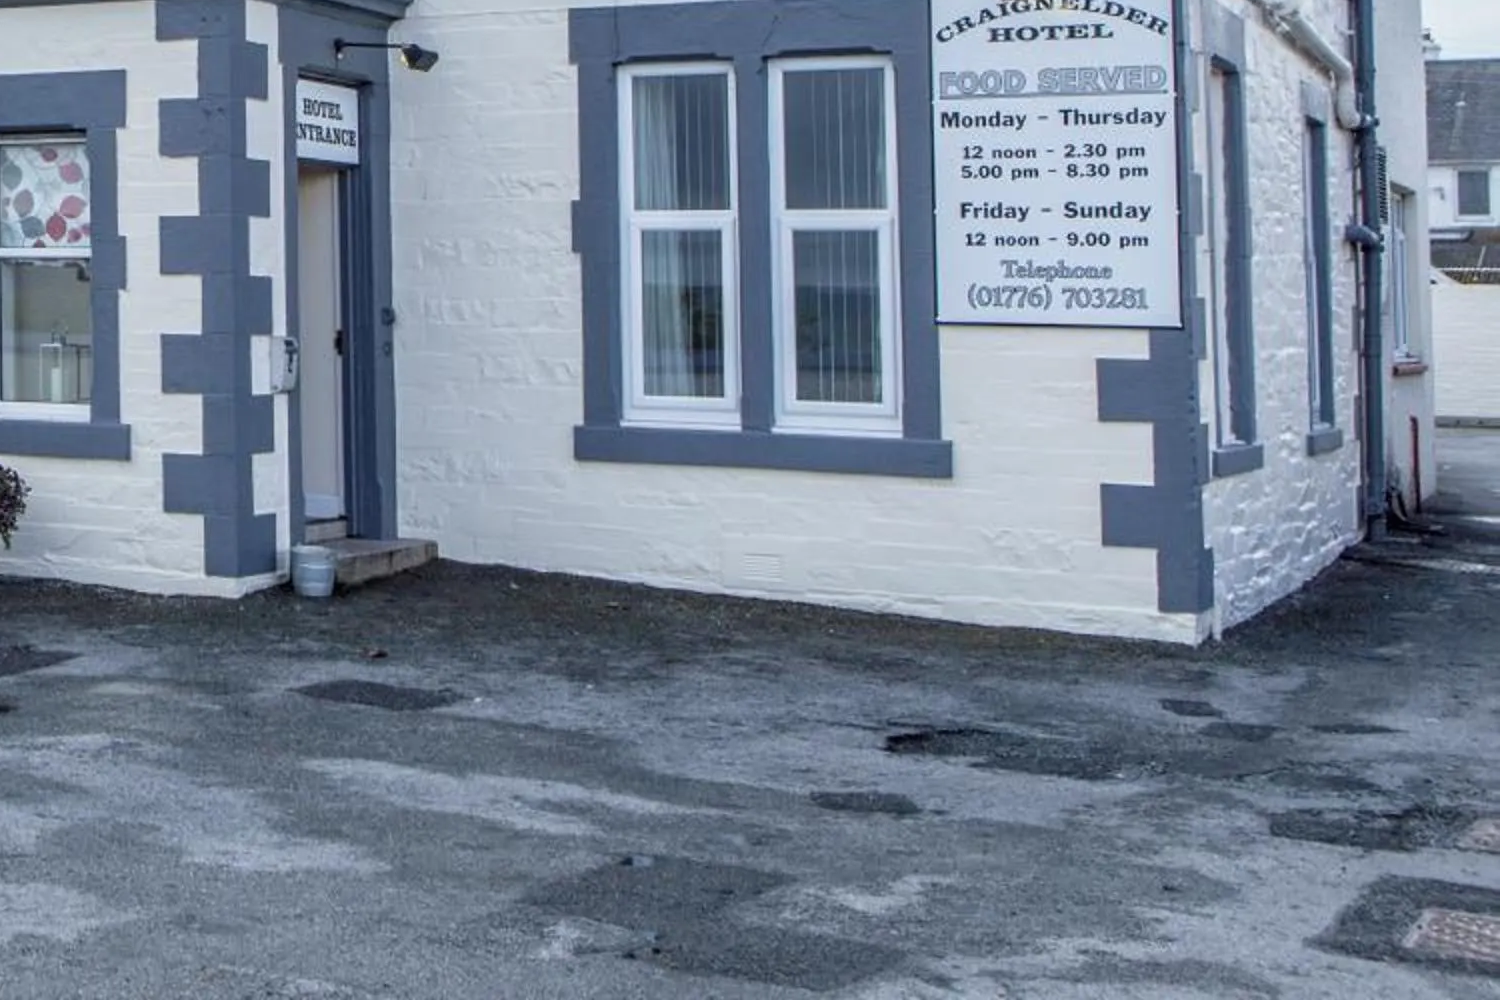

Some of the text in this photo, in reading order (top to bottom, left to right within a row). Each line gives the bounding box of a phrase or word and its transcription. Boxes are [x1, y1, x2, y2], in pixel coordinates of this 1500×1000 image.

[987, 23, 1114, 43] HOTEL
[939, 65, 1168, 95] FOOD SERVED
[303, 97, 343, 121] HOTEL
[940, 111, 1027, 131] Monday
[1058, 108, 1167, 128] Thursday
[296, 122, 357, 147] NTRANCE
[962, 145, 984, 160] 12
[991, 147, 1038, 160] noon
[1063, 143, 1108, 159] 2.30
[1116, 145, 1146, 160] pm
[961, 165, 1003, 179] 5.00
[1011, 166, 1040, 181] pm
[1066, 163, 1111, 178] 8.30
[1119, 165, 1149, 180] pm
[960, 202, 1030, 222] Friday
[1063, 201, 1152, 222] Sunday
[965, 233, 987, 247] 12
[994, 235, 1040, 247] noon
[1067, 232, 1111, 247] 9.00
[1119, 234, 1150, 249] pm
[1000, 259, 1113, 282] Telephone
[967, 283, 1150, 310] (01776) 703281
